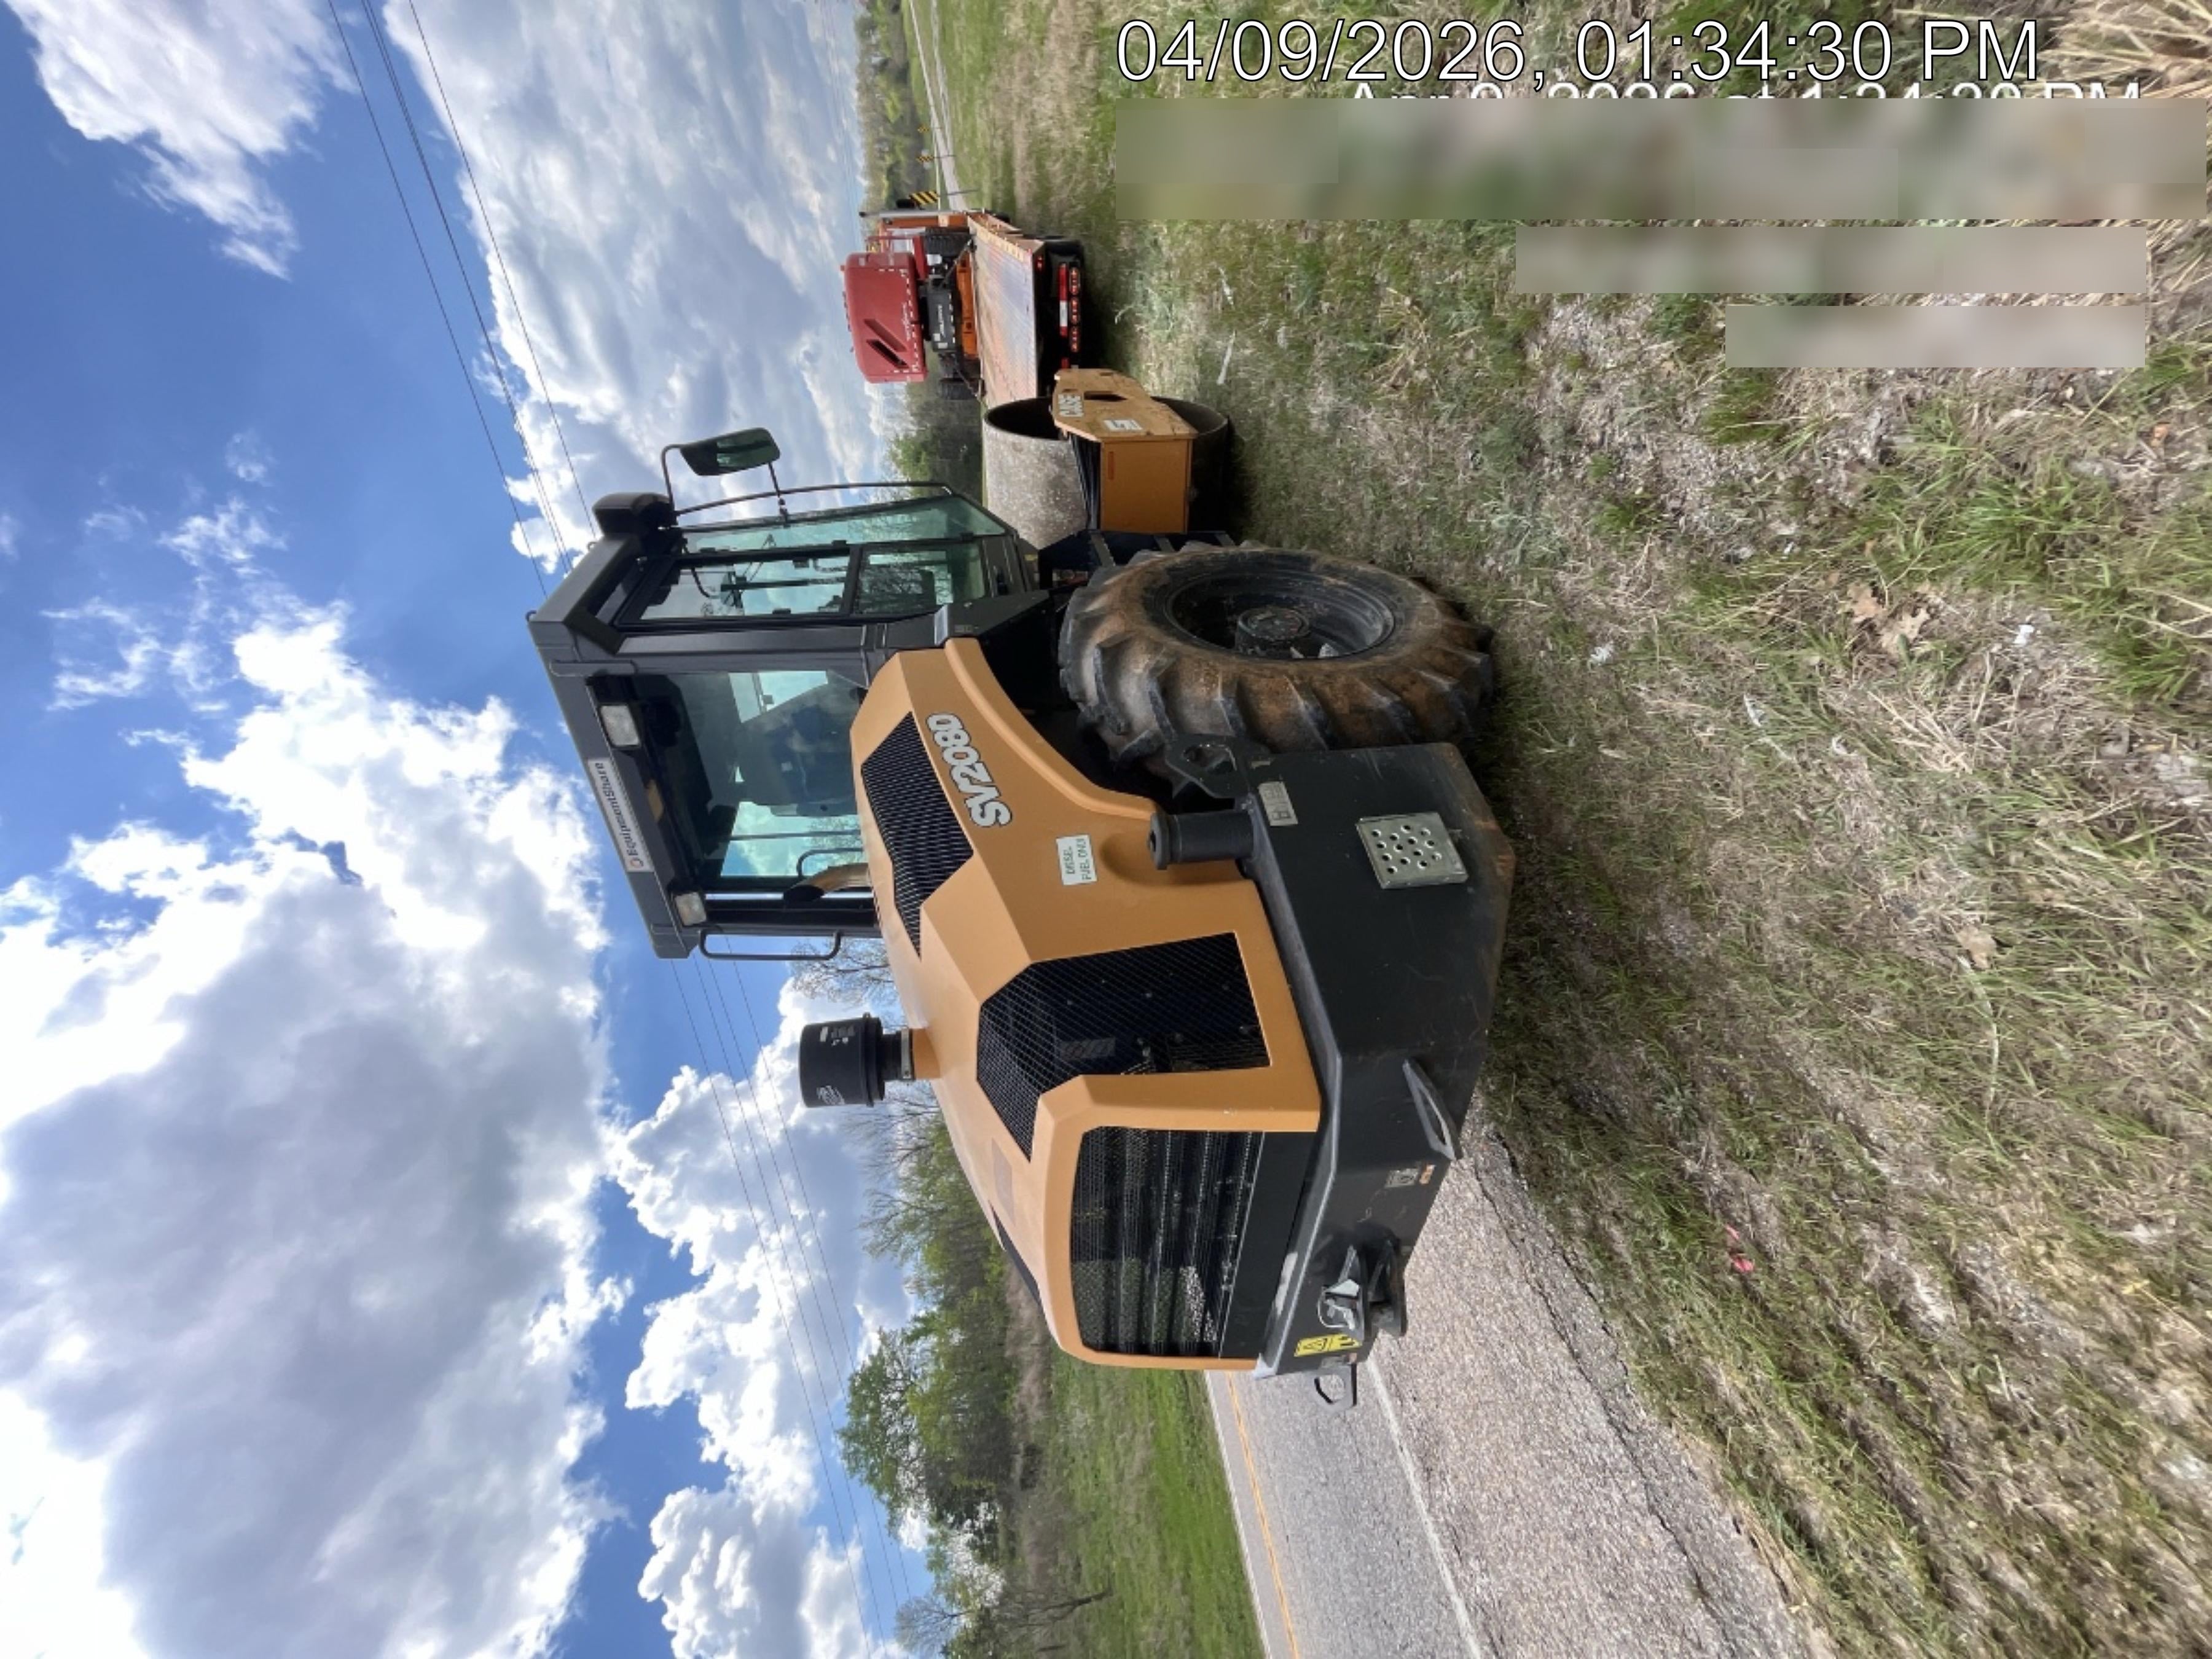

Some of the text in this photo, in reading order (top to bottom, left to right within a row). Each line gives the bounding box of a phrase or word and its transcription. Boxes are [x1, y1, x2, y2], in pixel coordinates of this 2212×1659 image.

[1058, 394, 1084, 417] CASE
[594, 763, 638, 856] EquipmentShare
[925, 713, 1012, 828] SV208D
